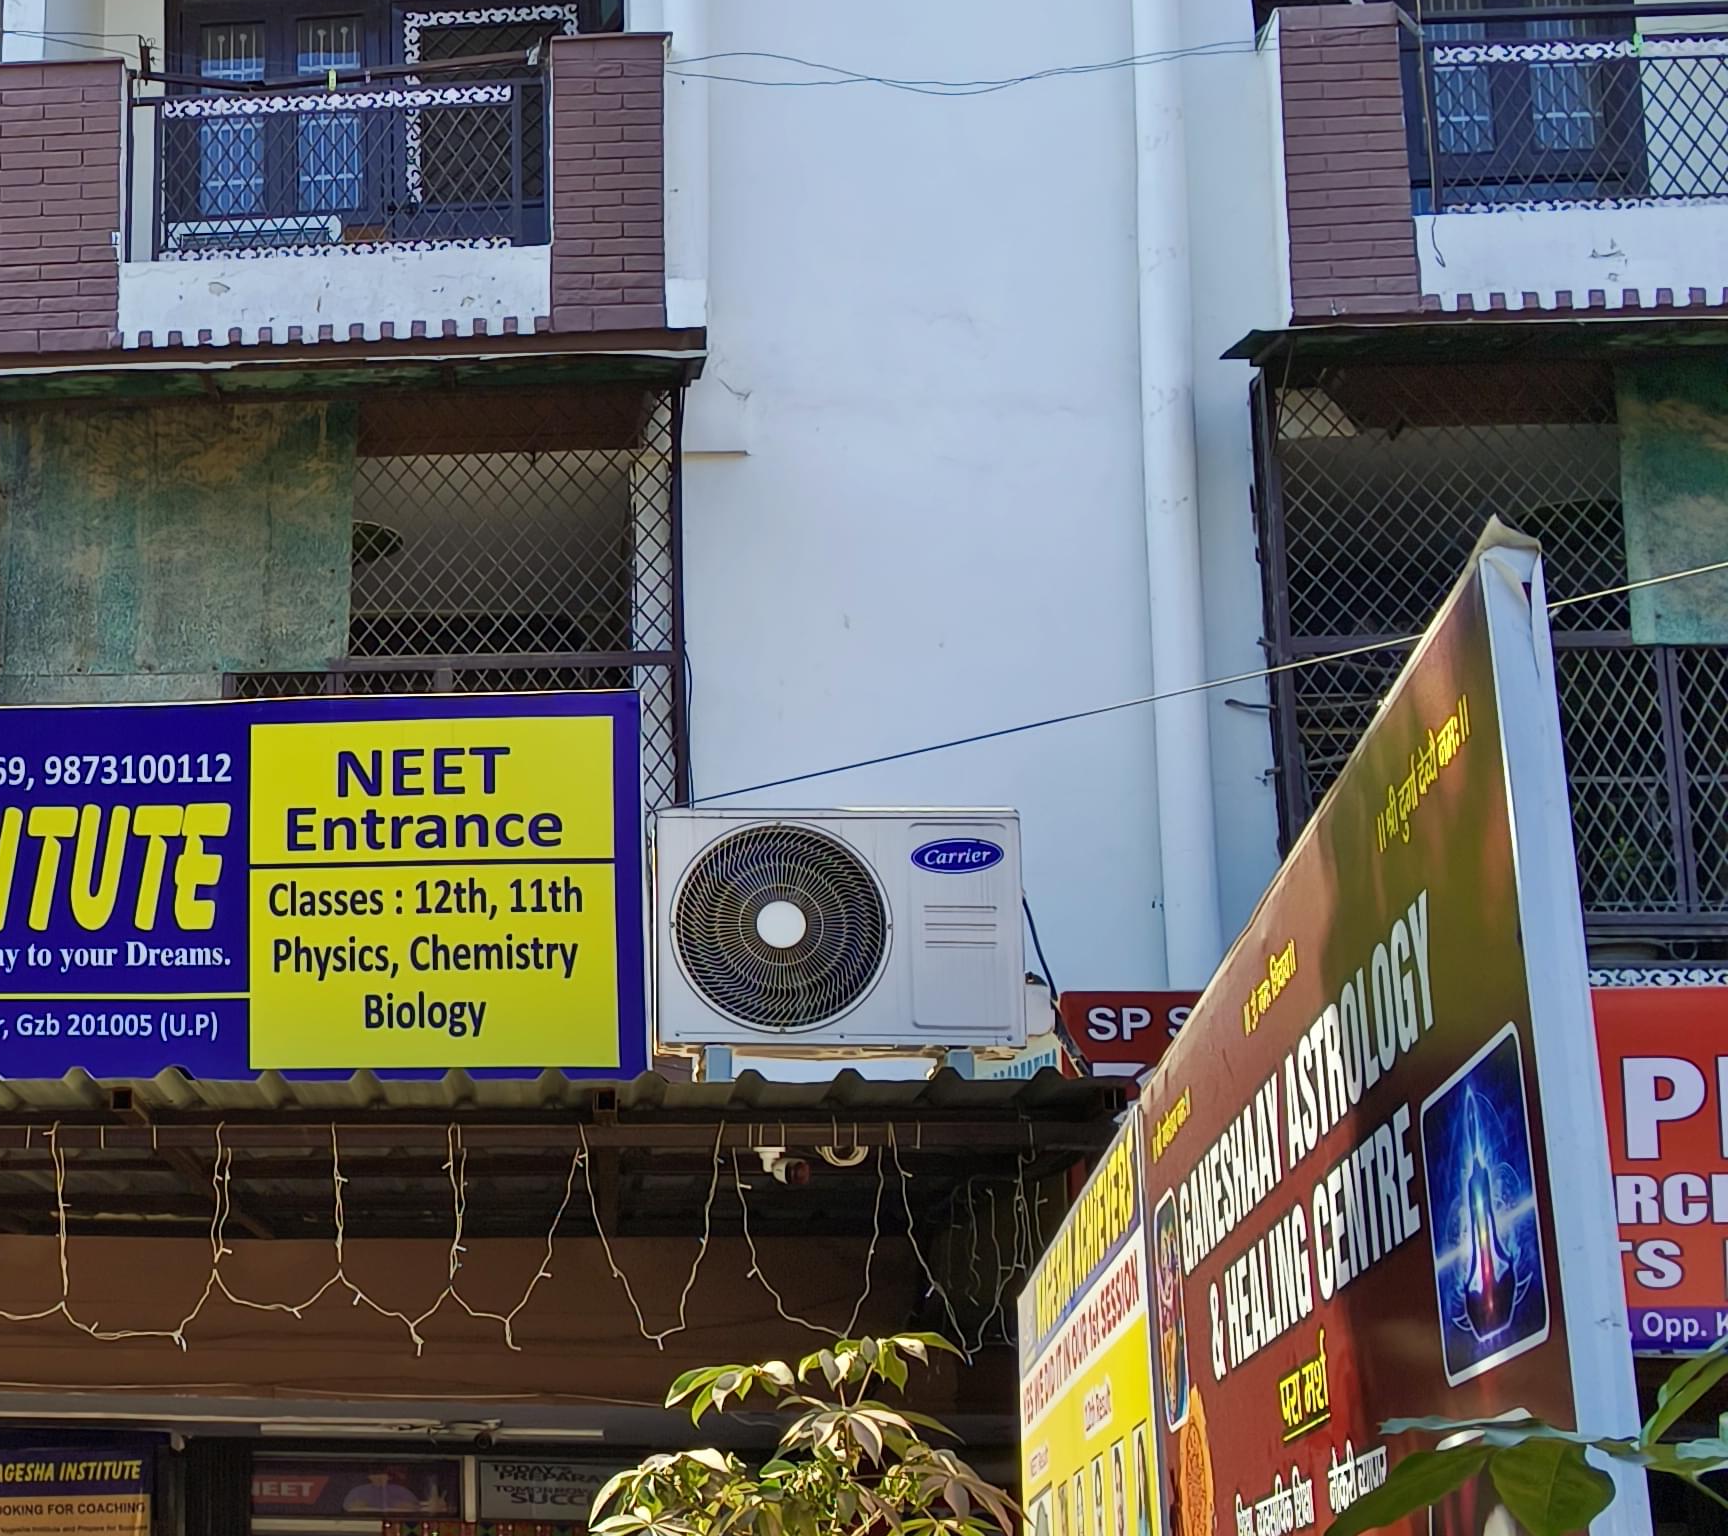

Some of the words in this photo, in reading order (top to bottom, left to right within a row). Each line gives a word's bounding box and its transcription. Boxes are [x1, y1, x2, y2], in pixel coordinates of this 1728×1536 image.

[43, 753, 233, 787] 9873100112
[337, 746, 511, 798] NEET
[286, 807, 563, 852] Entrance
[923, 846, 992, 867] Carrier
[268, 879, 384, 917] Classes
[415, 878, 498, 921] 12th,
[509, 876, 583, 913] 11th
[27, 944, 52, 967] to
[60, 946, 118, 972] your
[124, 940, 232, 967] Dreams.
[273, 935, 400, 982] Physics,
[409, 933, 579, 979] Chemistry
[16, 1012, 60, 1038] Gzb
[67, 1012, 152, 1037] 201005
[159, 1010, 218, 1042] (U.P)
[364, 991, 487, 1037] Biology
[1087, 1007, 1151, 1041] SP
[1179, 1071, 1282, 1277] GANESHAAY
[1285, 888, 1435, 1171] ASTROLOGY
[1073, 1125, 1136, 1293] ACHIEVERS
[1210, 1279, 1225, 1382] &
[1223, 1201, 1314, 1370] HEALING
[1314, 1102, 1421, 1303] CENTRE
[1101, 1248, 1139, 1336] SESSION
[1641, 1310, 1707, 1348] Opp.
[59, 1459, 142, 1482] INSTITUTE
[48, 1503, 74, 1515] FOR
[78, 1501, 145, 1514] COACHING
